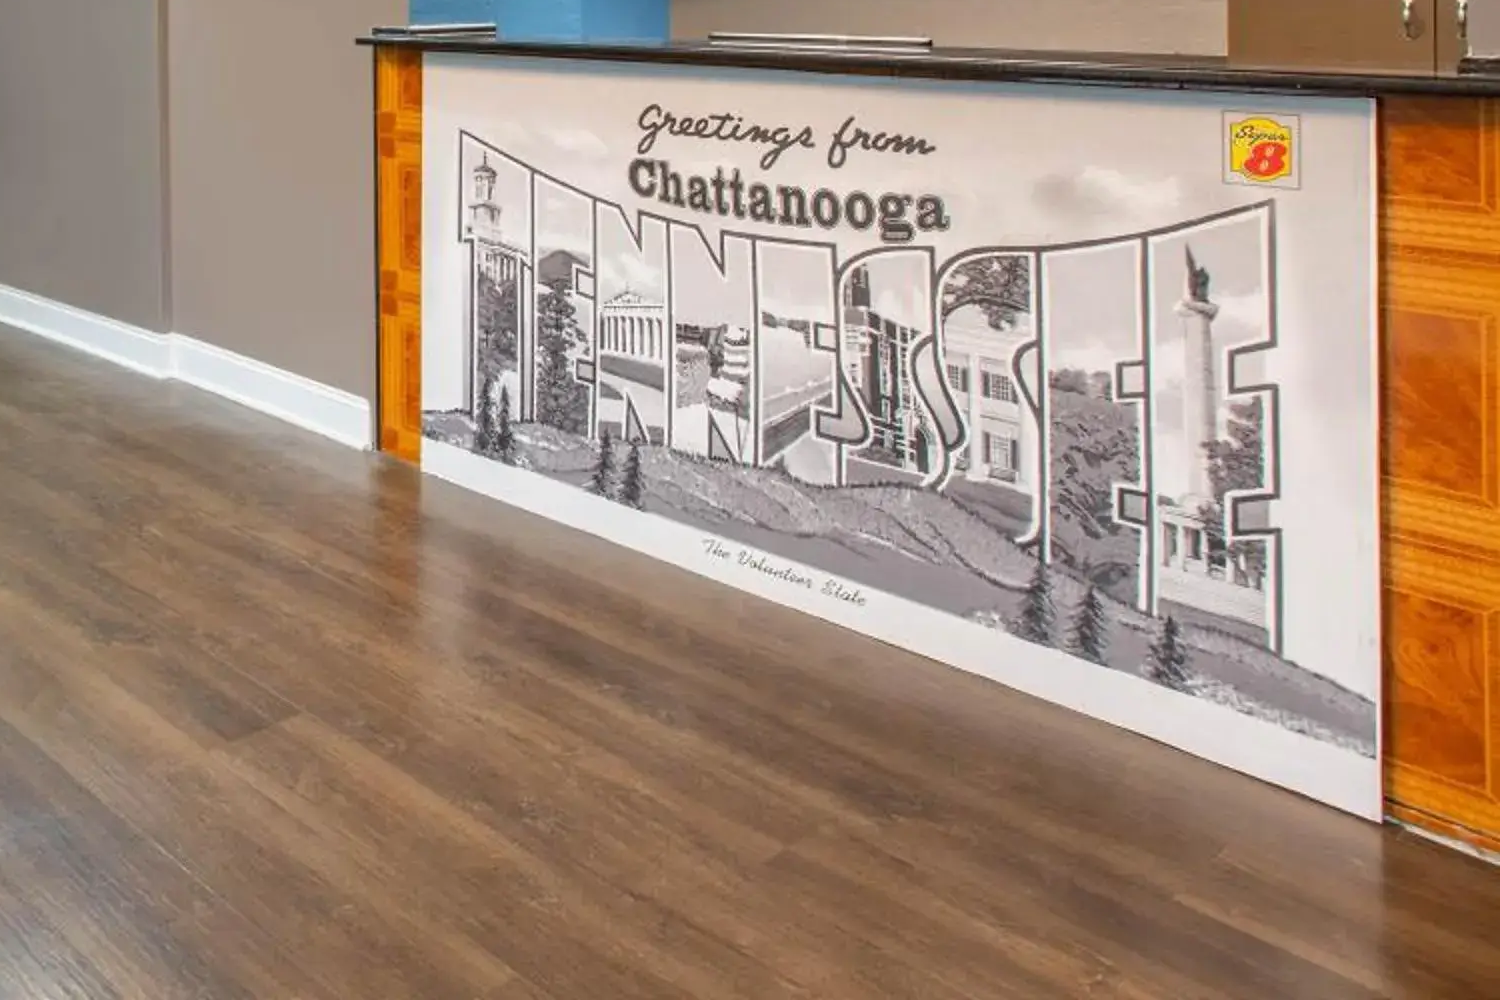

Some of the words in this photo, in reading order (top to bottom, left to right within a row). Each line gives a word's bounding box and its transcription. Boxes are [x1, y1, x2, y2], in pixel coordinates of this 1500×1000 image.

[638, 103, 816, 170] Greetings
[826, 115, 937, 169] from
[1243, 141, 1286, 177] 8
[627, 156, 952, 243] Chattanooga
[459, 130, 1283, 656] TENNESSEE
[701, 538, 732, 560] The
[736, 549, 814, 590] Volunteer
[820, 578, 867, 607] State
